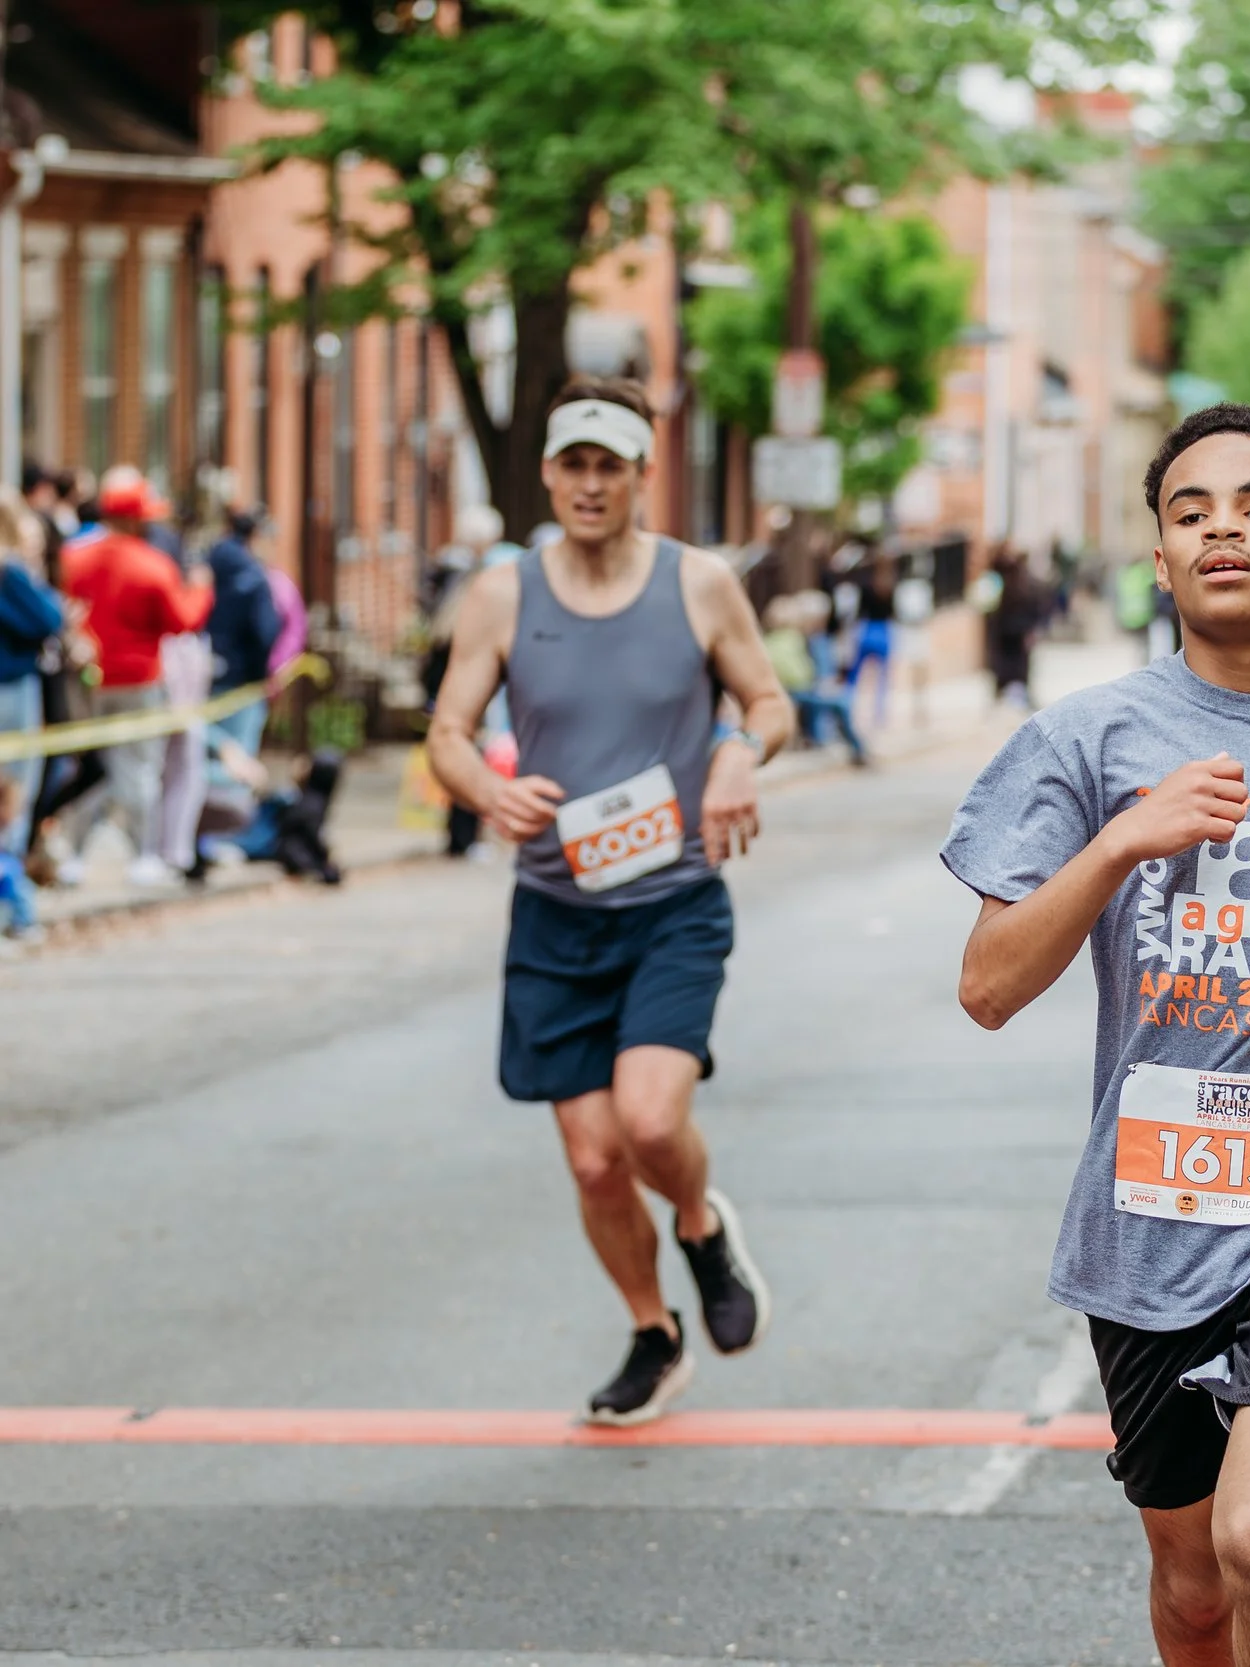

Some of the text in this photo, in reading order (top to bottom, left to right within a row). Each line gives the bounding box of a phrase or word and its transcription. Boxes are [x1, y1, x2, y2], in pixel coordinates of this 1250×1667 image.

[577, 808, 676, 869] 6002
[1136, 857, 1171, 962] ywc
[1139, 971, 1228, 1004] APRIL
[1210, 1075, 1228, 1083] Years
[1197, 1082, 1206, 1112] ywca
[1197, 1113, 1219, 1121] APRIL
[1130, 1193, 1157, 1204] ywca
